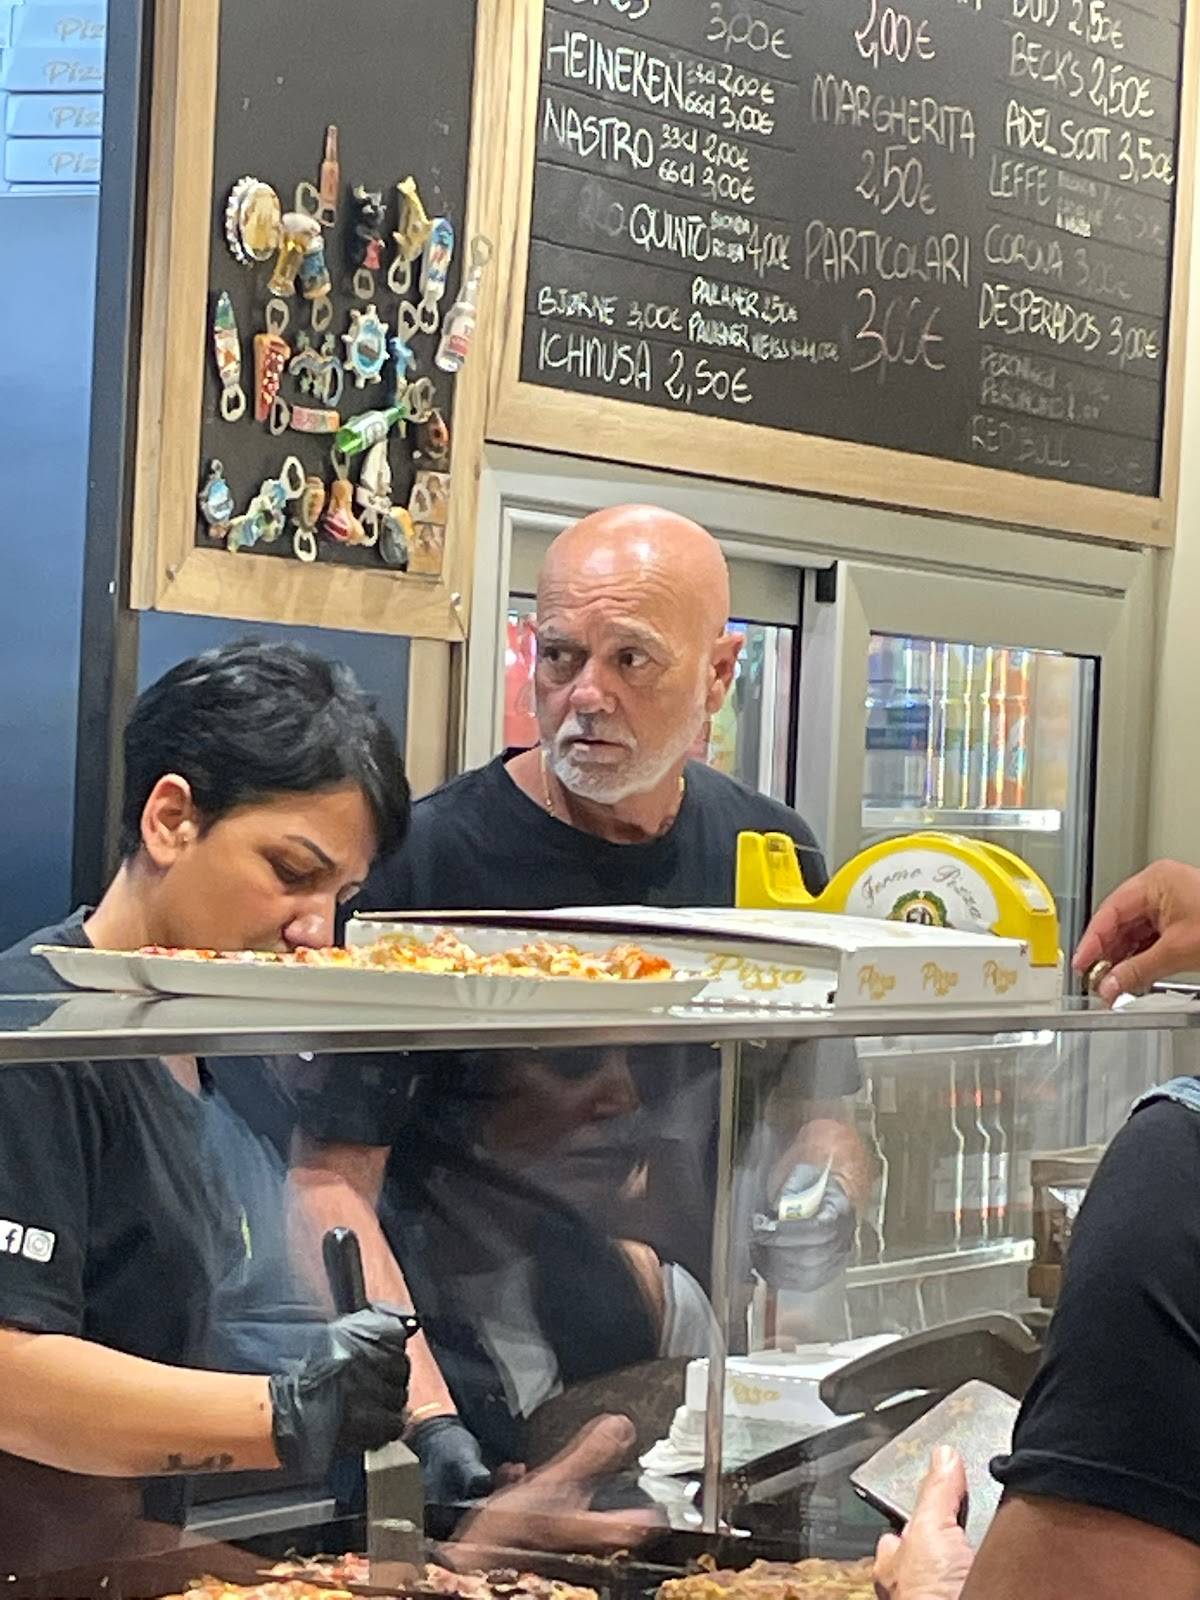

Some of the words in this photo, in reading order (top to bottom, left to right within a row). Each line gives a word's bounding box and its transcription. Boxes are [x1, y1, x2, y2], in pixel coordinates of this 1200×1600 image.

[547, 29, 684, 110] HEINEKEN
[1088, 55, 1155, 118] 2,50€
[543, 97, 654, 169] NASTRO
[811, 72, 976, 159] MARGHERITA
[855, 144, 937, 214] 2,50€
[989, 153, 1052, 207] LEFFE
[629, 202, 712, 264] QUINTO
[804, 219, 970, 289] PARTICOLARI
[978, 281, 1101, 352] DESPERADOS
[538, 327, 652, 392] ICHNUSA
[663, 348, 754, 406] 2,50€
